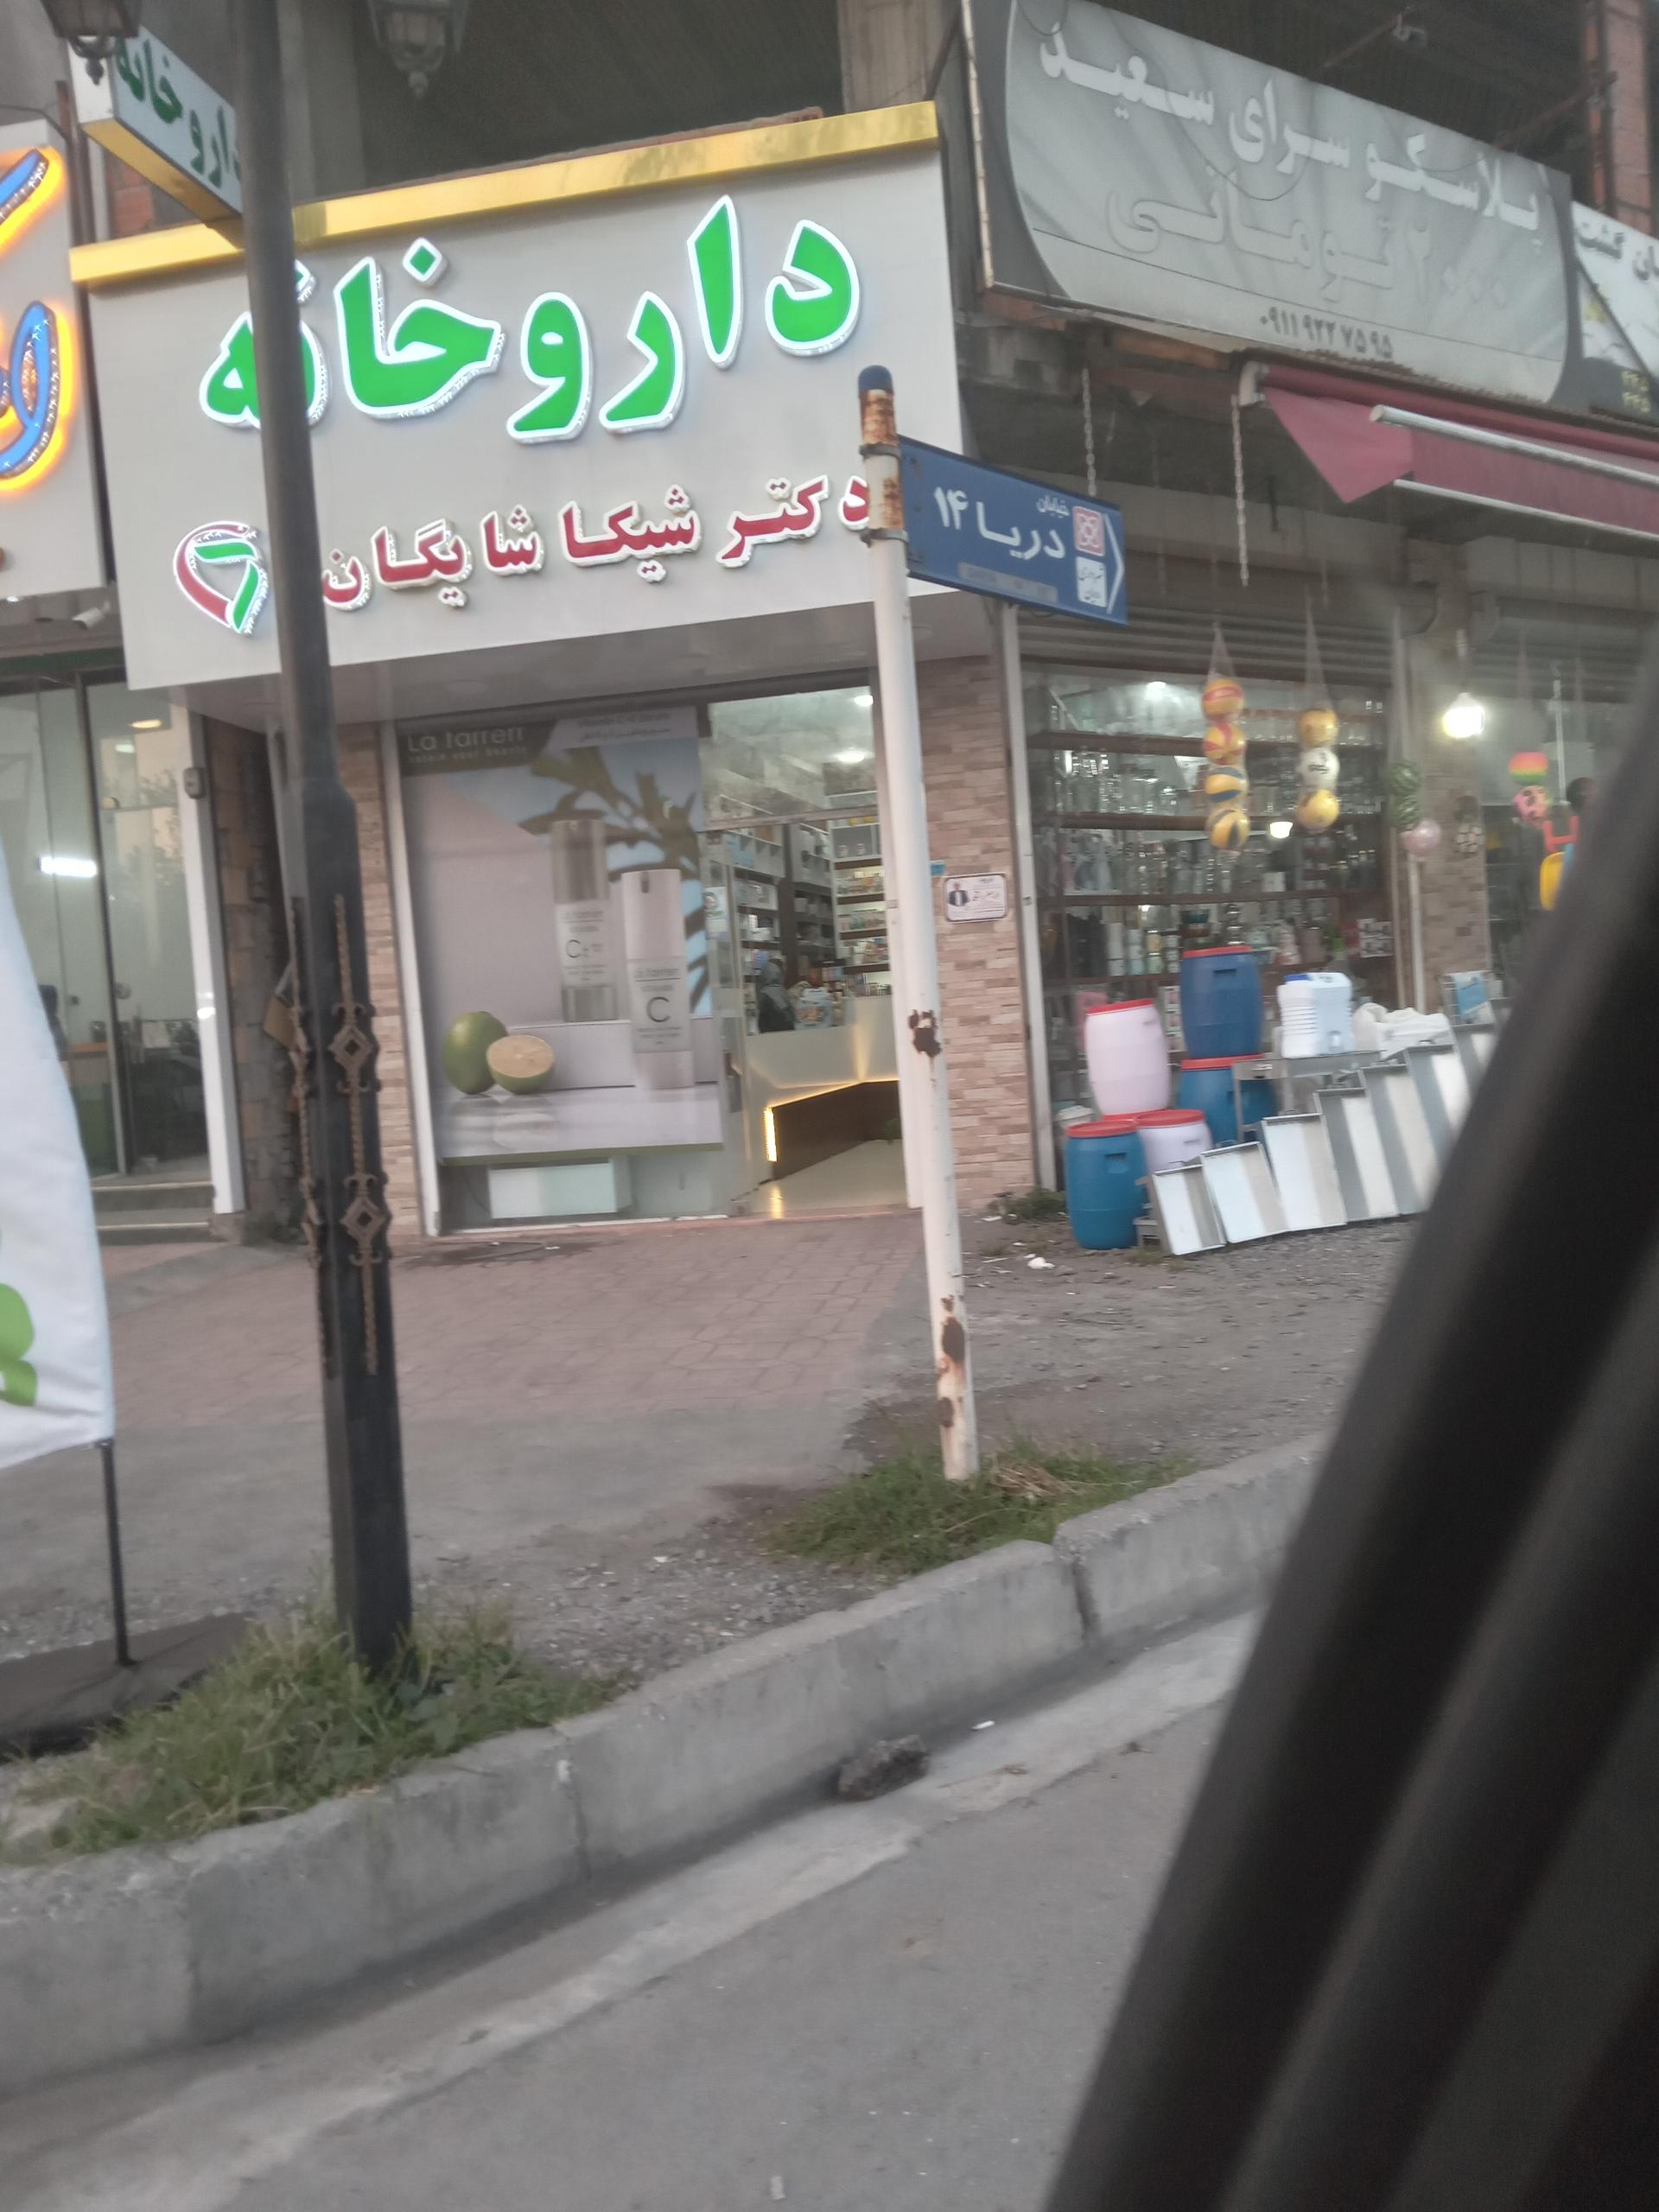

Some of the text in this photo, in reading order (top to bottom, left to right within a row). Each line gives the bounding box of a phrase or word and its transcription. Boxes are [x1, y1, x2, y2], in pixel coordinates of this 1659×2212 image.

[1040, 22, 1539, 252] پلاسکو سرای سعید
[323, 474, 868, 611] دکتر شیکا شایگان
[934, 486, 1065, 560] دریا ۱۴
[647, 996, 671, 1023] C
